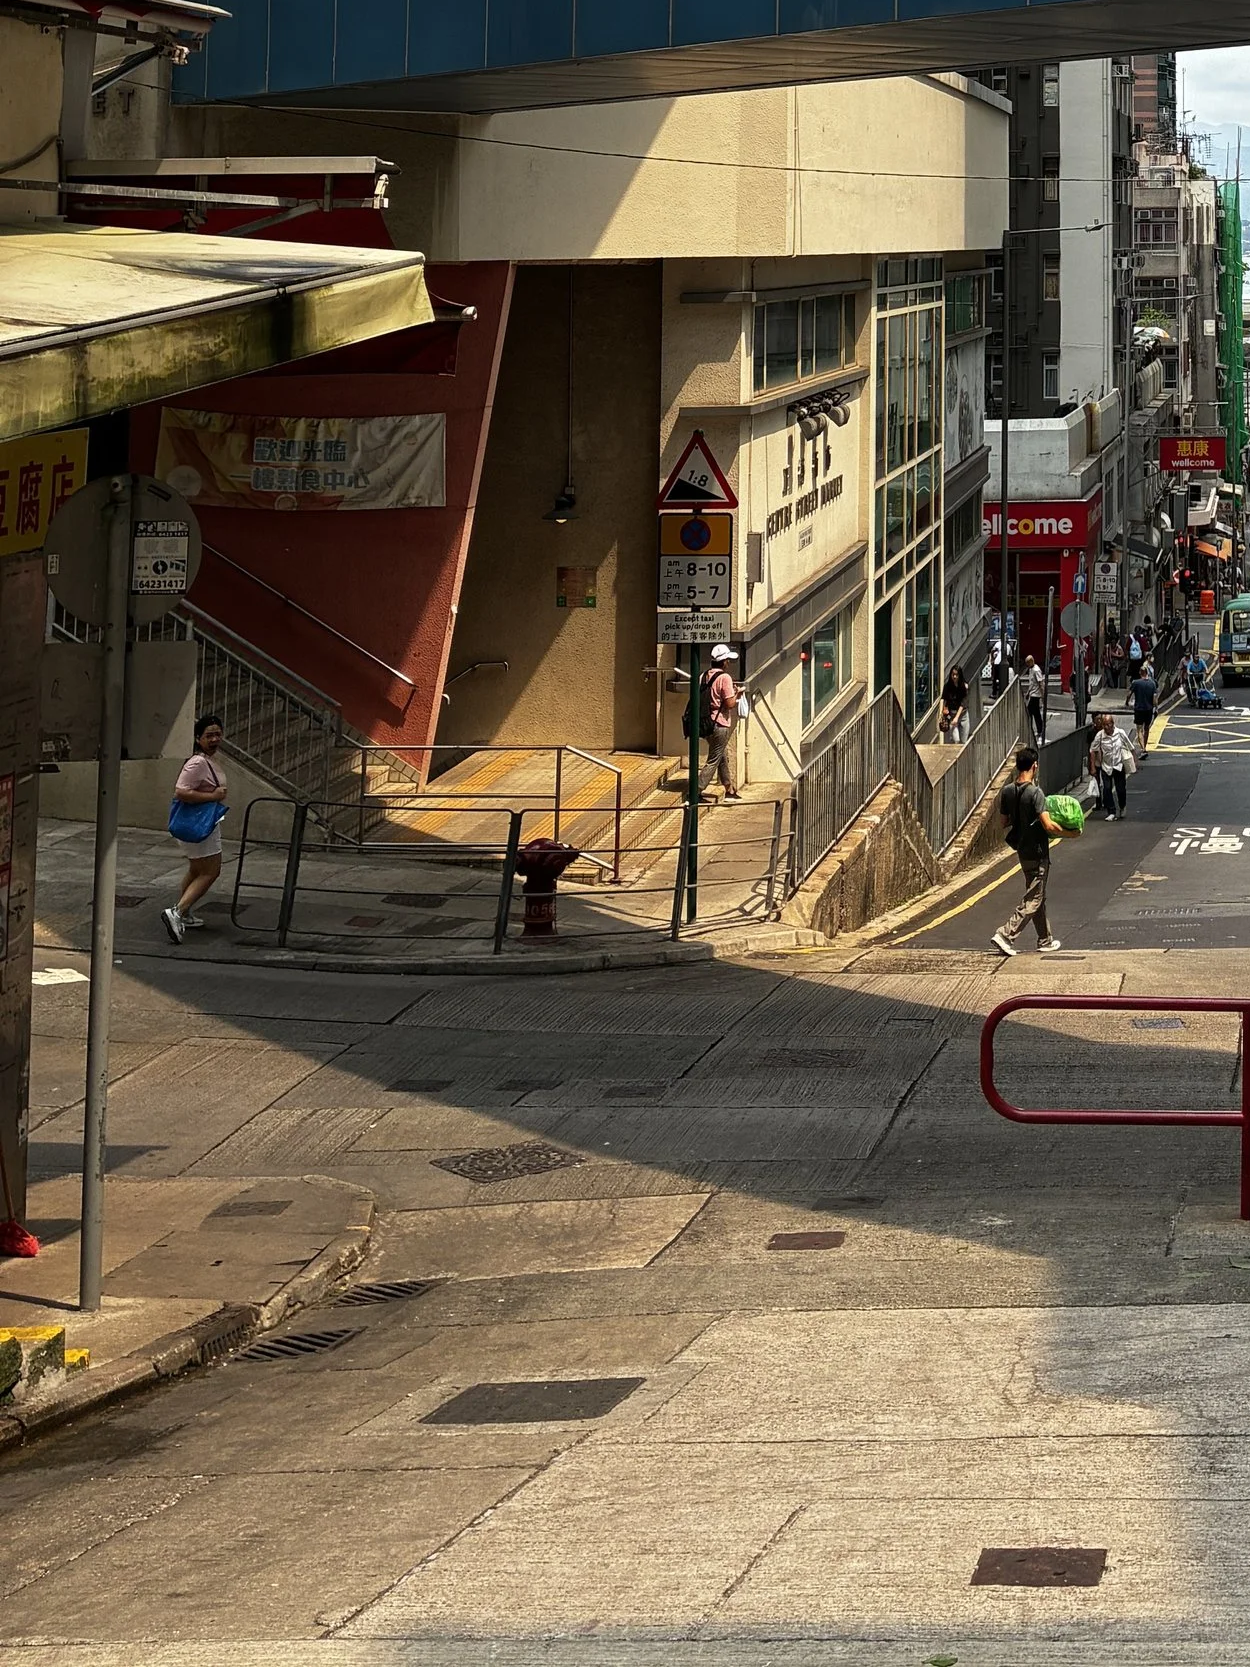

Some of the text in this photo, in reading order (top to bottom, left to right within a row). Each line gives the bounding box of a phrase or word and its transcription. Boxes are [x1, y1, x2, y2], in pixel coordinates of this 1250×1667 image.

[255, 438, 347, 462] 歡迎光臨
[1177, 439, 1209, 457] 惠康
[1171, 457, 1215, 468] wellcome
[230, 466, 370, 491] 一樓熟食中心
[687, 470, 708, 487] 1:8
[981, 513, 1073, 535] ellcome
[664, 568, 684, 578] 上午
[687, 562, 727, 577] 8-10
[138, 579, 185, 589] 64231417
[667, 583, 680, 591] pm
[663, 592, 684, 602] 下午
[674, 614, 715, 623] Except taxi
[665, 623, 680, 631] pick
[682, 623, 711, 631] up/drop
[661, 631, 727, 642] 的士上落客除外
